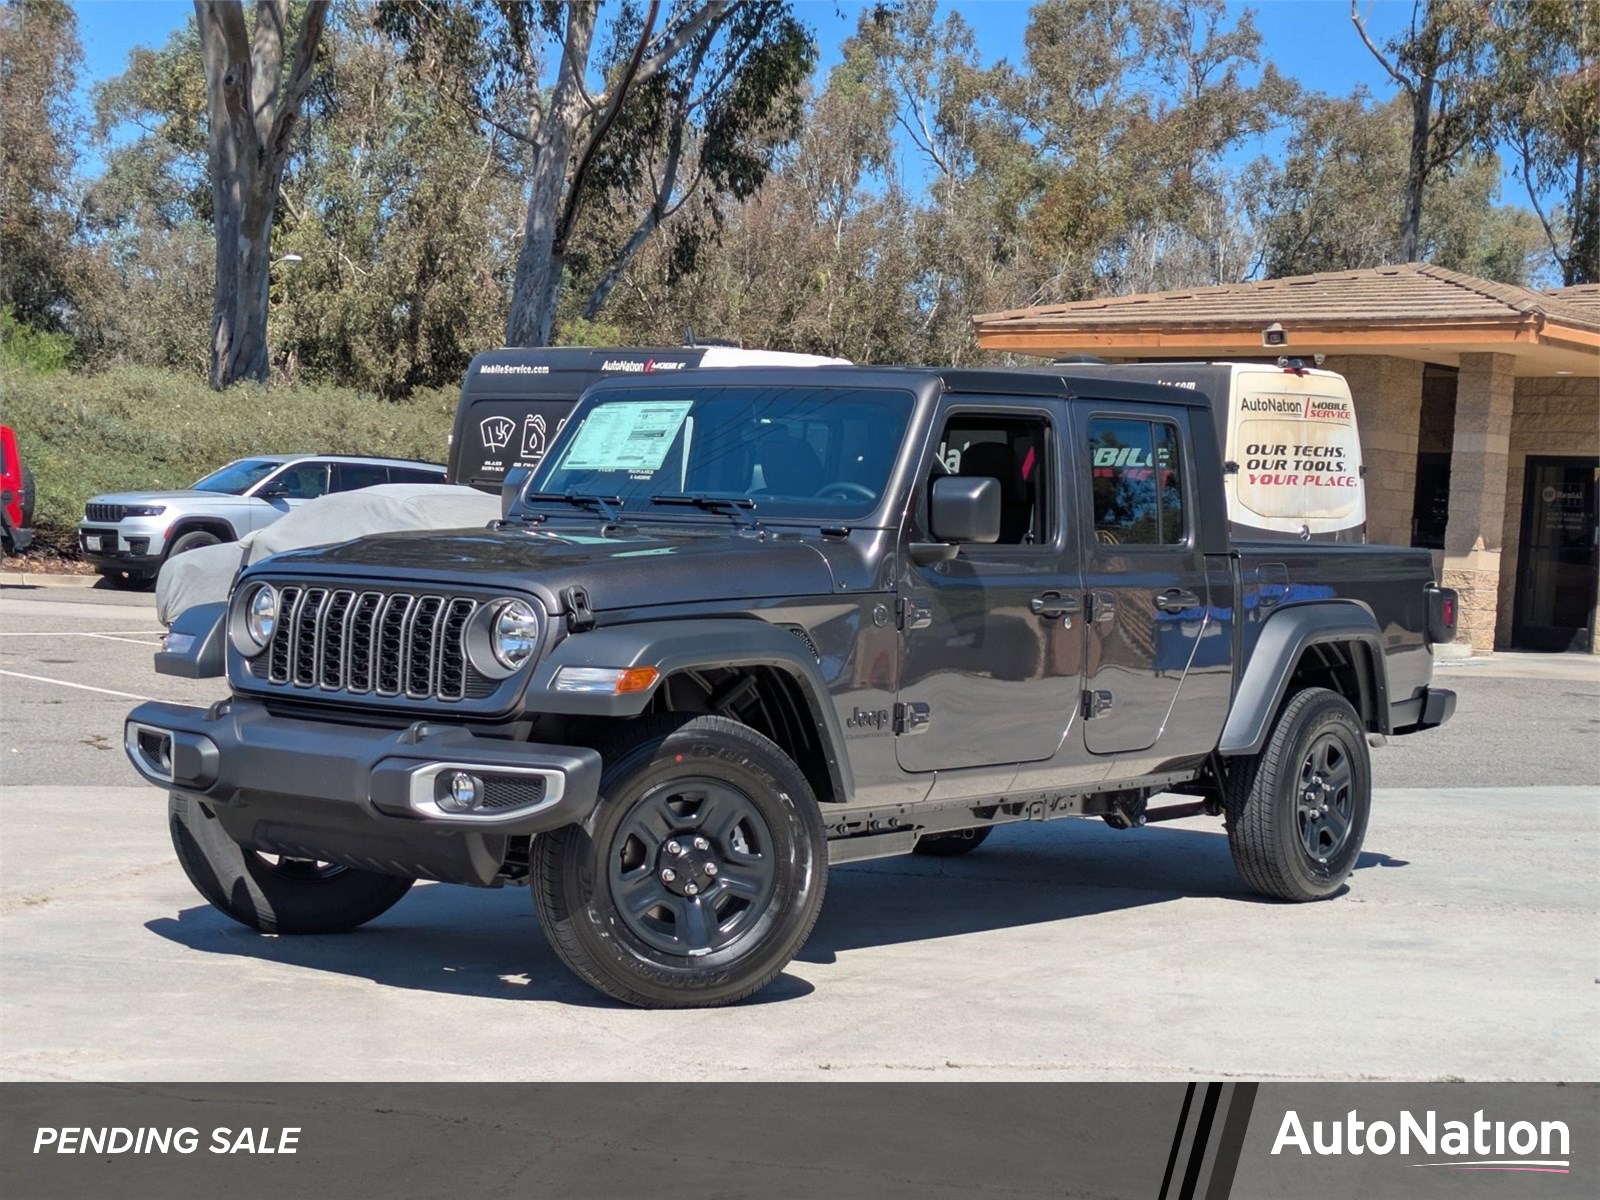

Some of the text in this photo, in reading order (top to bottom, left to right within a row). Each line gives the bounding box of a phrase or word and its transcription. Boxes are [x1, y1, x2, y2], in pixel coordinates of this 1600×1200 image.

[480, 364, 550, 374] MobileService.com
[601, 360, 645, 373] AutoNation
[1241, 397, 1303, 413] AutoNation
[1311, 401, 1348, 411] MOBILE
[1310, 409, 1351, 420] SERVICE
[1246, 444, 1347, 459] OUR TECHS.
[1247, 459, 1347, 473] OUR TOOLS.
[1249, 474, 1358, 488] YOUR PLACE.
[846, 707, 889, 730] Jeep
